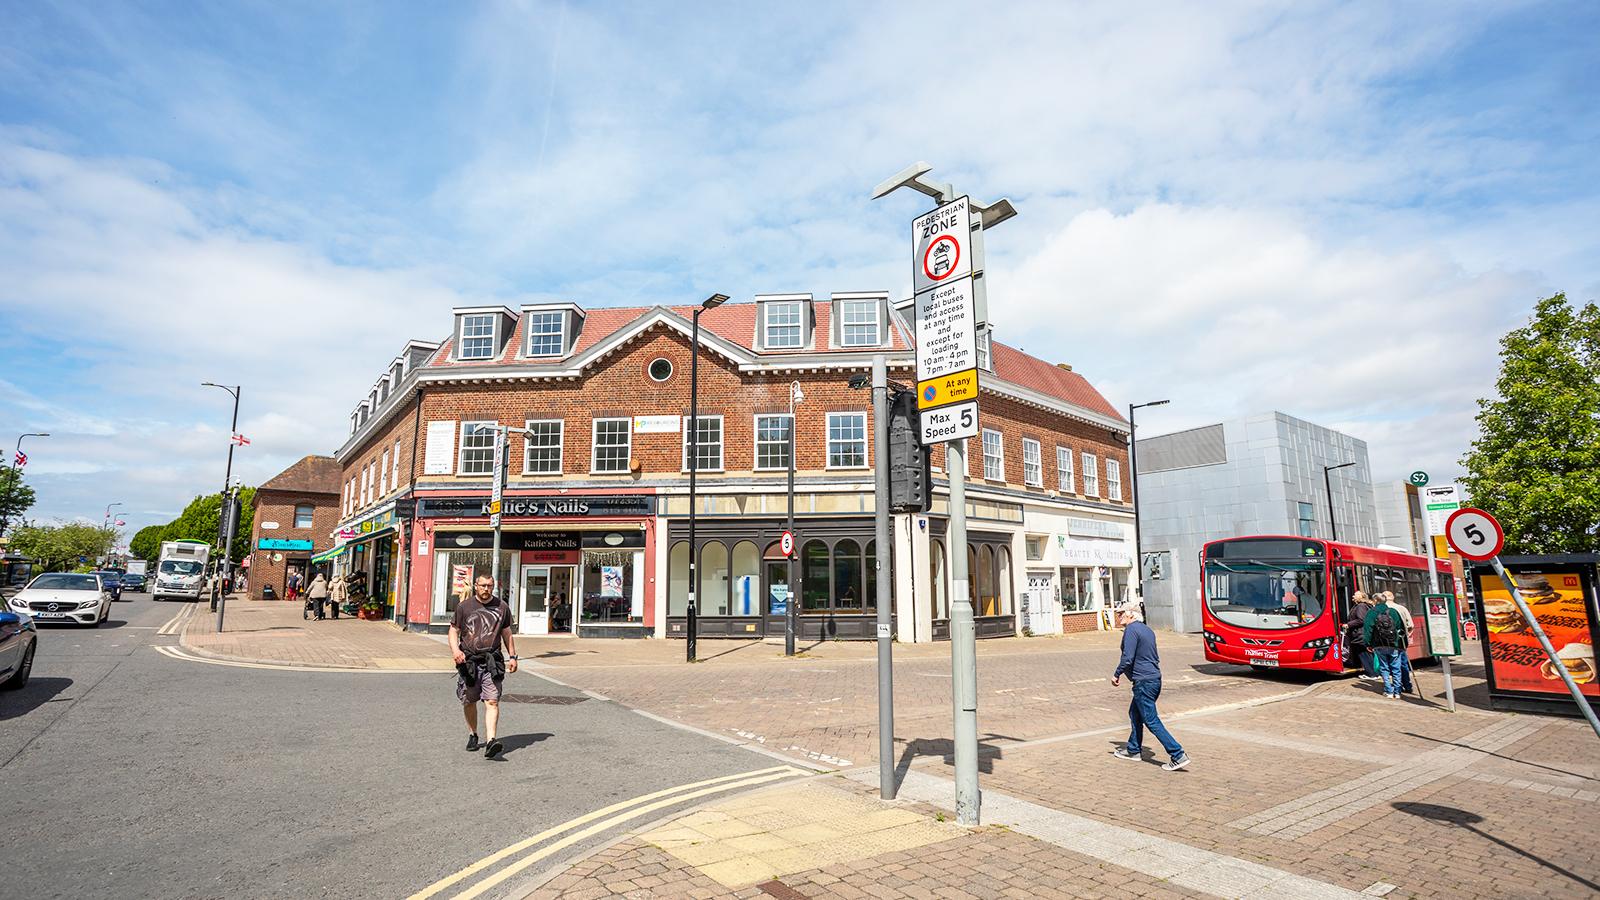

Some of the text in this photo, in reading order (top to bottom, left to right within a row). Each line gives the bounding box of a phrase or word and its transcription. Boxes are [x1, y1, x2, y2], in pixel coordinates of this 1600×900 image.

[916, 202, 965, 229] PEDESTRIAN
[924, 215, 958, 239] ZONE
[930, 286, 956, 302] Except
[923, 295, 964, 313] local buses
[924, 304, 964, 321] and access
[924, 312, 965, 330] at any time
[937, 325, 951, 335] and
[926, 332, 964, 348] except for
[932, 342, 959, 355] loading
[946, 376, 971, 389] At any
[950, 387, 967, 397] time
[930, 408, 973, 428] Max 5
[925, 424, 956, 439] Speed
[1413, 474, 1426, 482] S2
[481, 499, 539, 514] Ktie's
[544, 499, 589, 514] Nails
[1463, 523, 1485, 546] 5
[784, 538, 790, 549] 5
